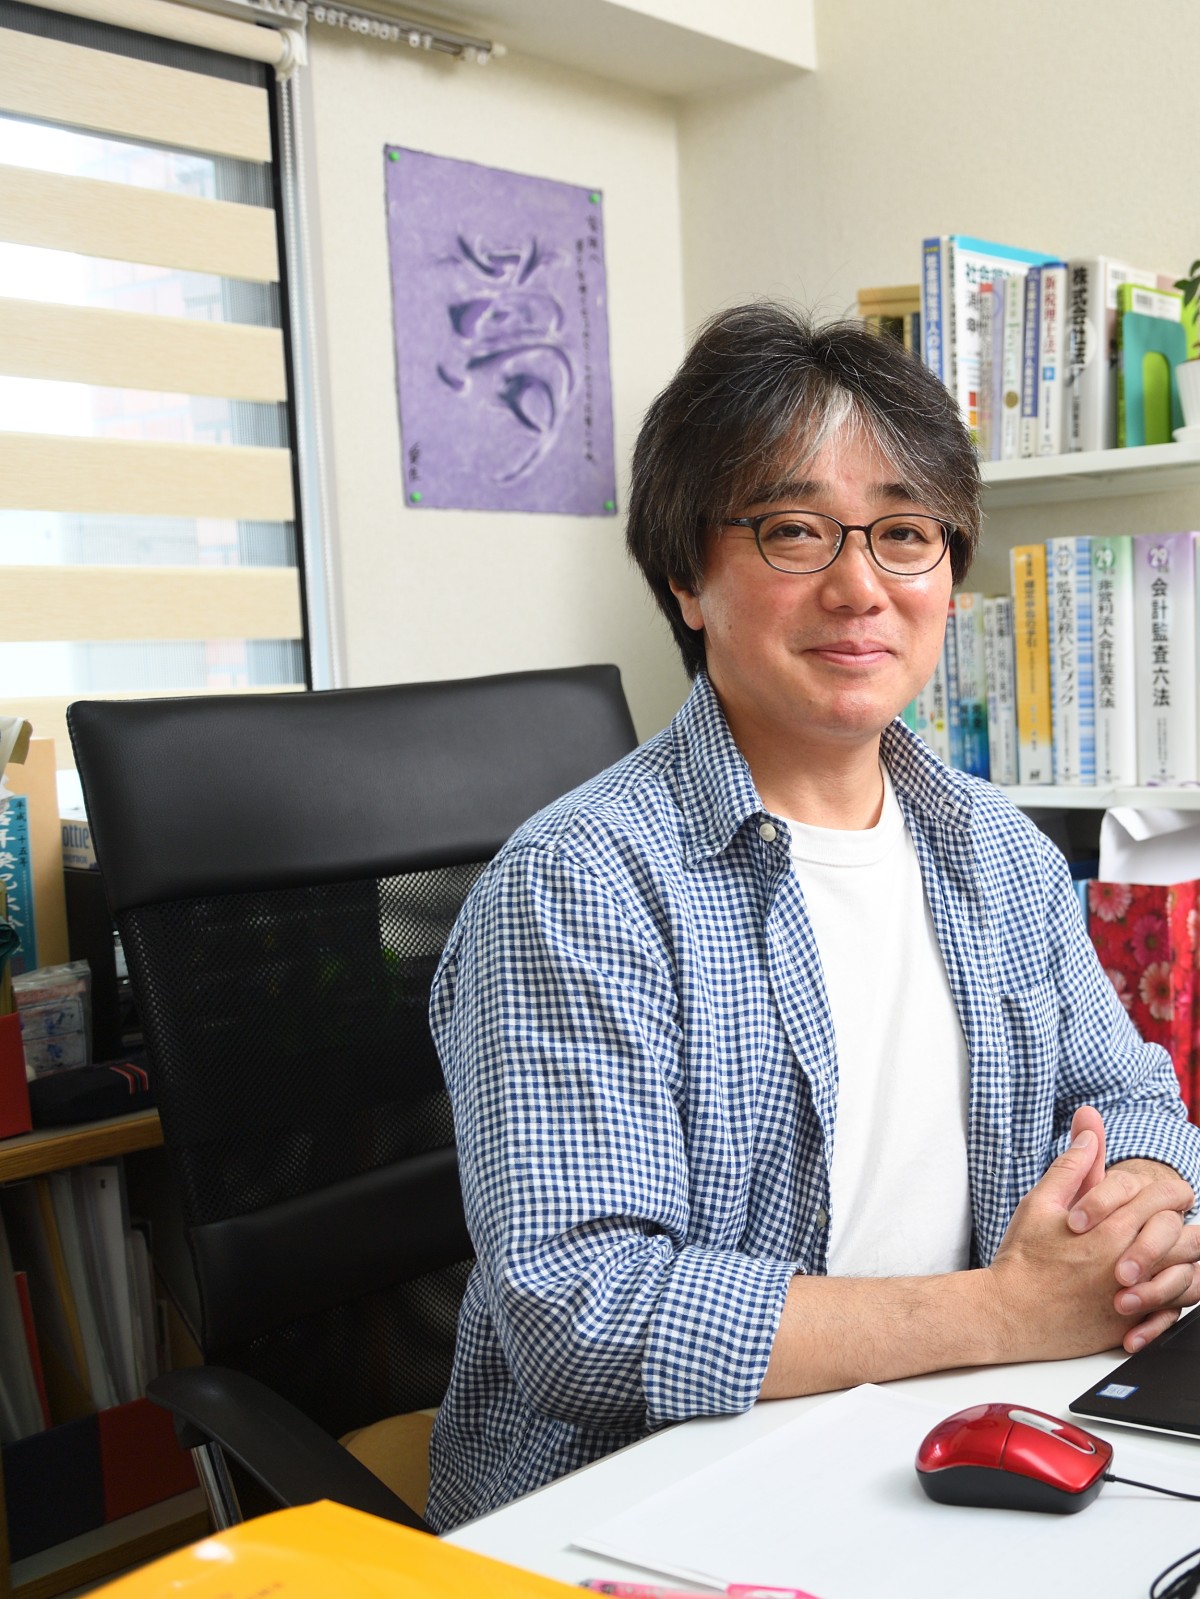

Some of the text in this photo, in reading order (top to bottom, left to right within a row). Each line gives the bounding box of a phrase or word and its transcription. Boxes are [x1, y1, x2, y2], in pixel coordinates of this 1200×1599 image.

[1096, 548, 1114, 568] 29
[1150, 547, 1169, 566] 29
[1056, 581, 1075, 707] 監査実務ハンドブック
[1098, 580, 1115, 709] 非営利法人会計監査六法
[1151, 577, 1170, 707] 会計監査六法
[16, 801, 28, 867] 平成二十五年
[62, 824, 89, 849] ottie
